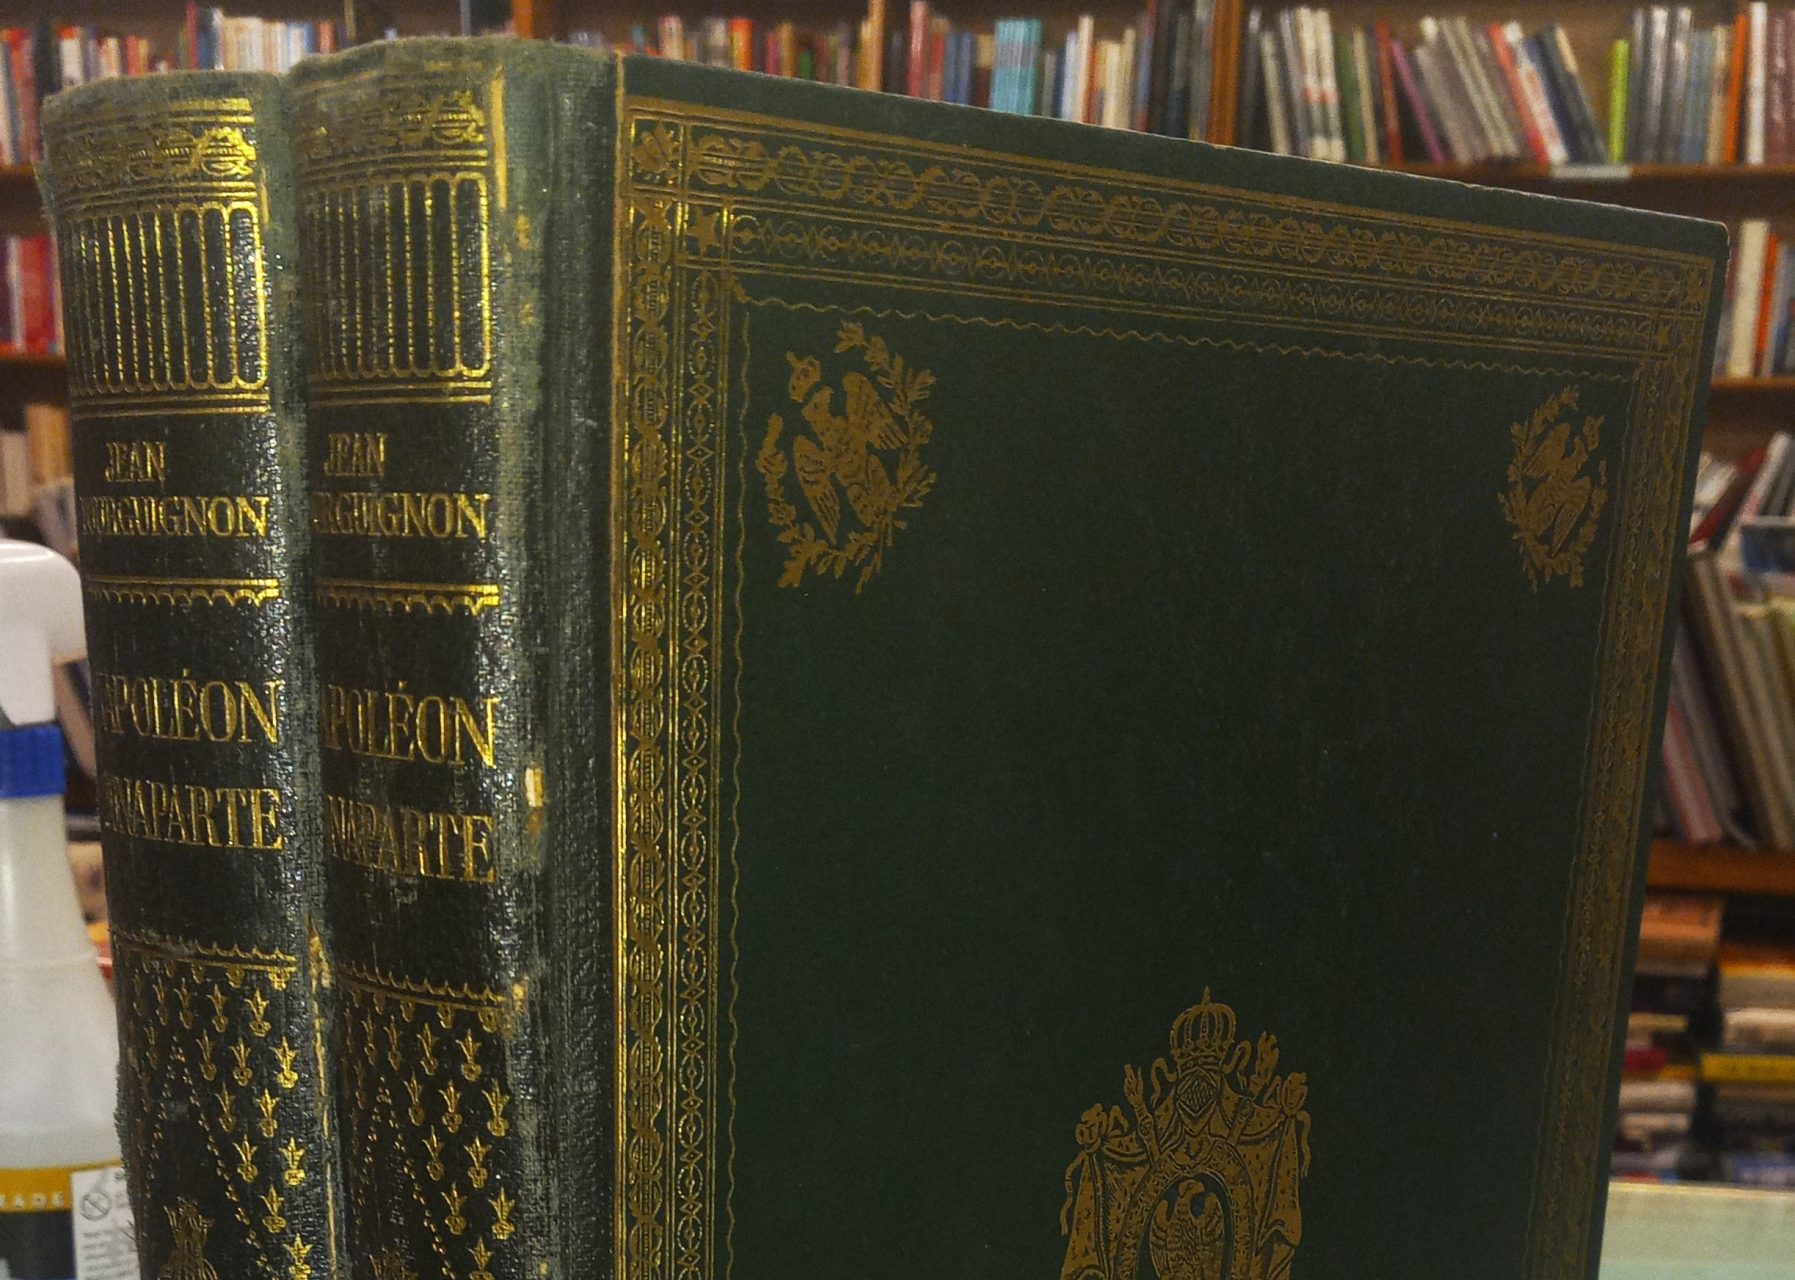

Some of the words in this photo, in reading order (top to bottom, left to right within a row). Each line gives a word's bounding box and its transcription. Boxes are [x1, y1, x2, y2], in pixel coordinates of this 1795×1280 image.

[105, 441, 166, 483] JEAN
[323, 432, 386, 478] JEAN
[313, 493, 491, 539] RGUIGNON
[104, 667, 281, 744] APOLÉON
[322, 681, 500, 769] POLÉON
[106, 776, 283, 850] NAPARTE
[326, 794, 498, 884] NAPARTE
